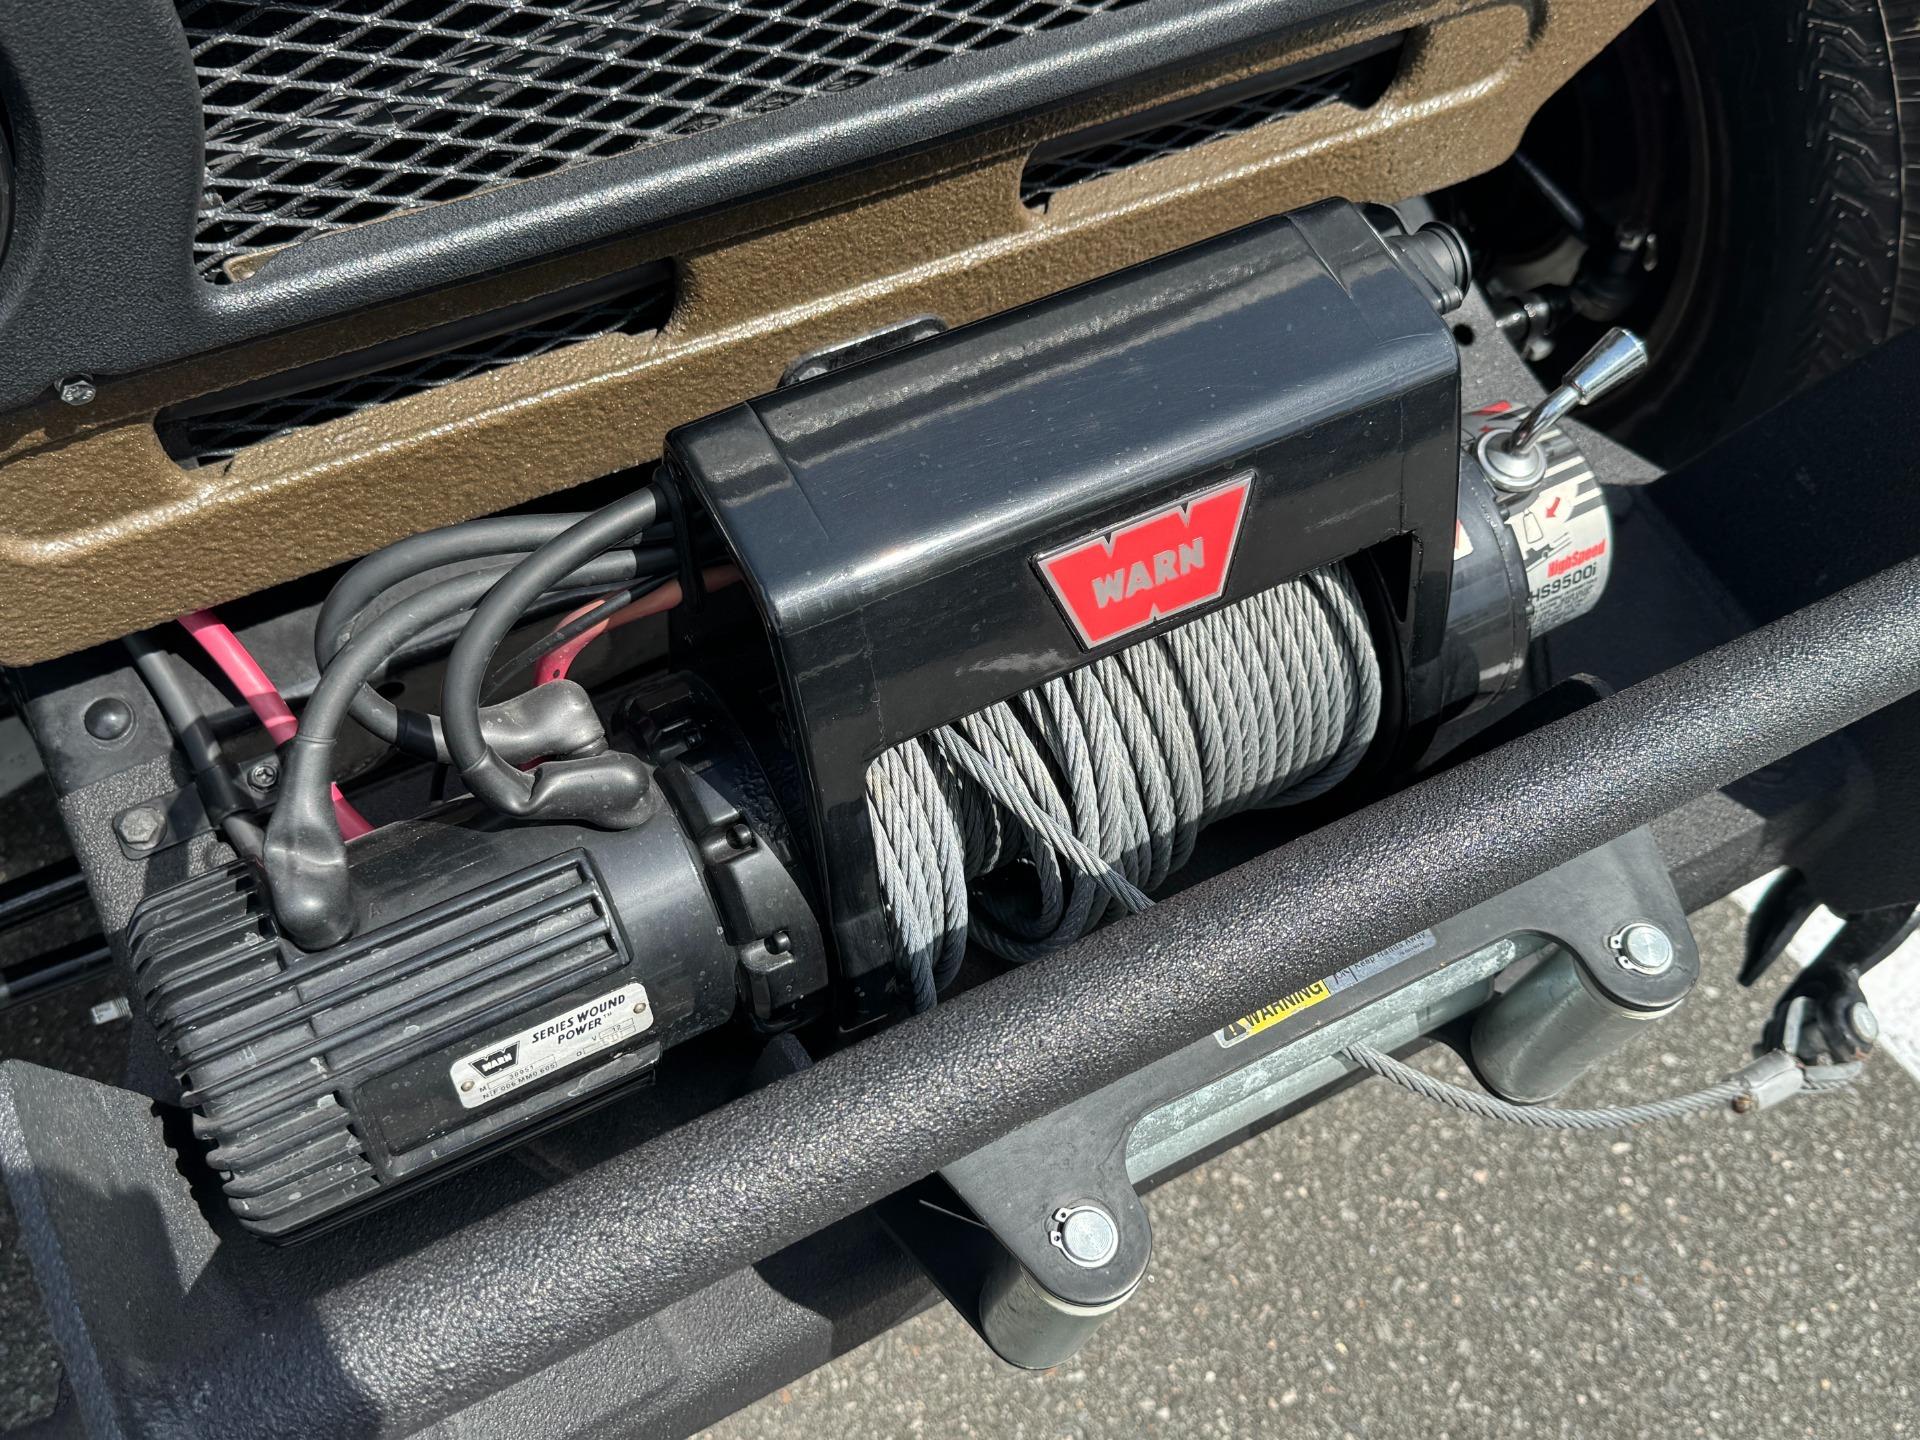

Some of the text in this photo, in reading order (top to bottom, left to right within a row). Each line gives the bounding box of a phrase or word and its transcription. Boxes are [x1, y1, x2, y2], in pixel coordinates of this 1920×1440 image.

[1090, 536, 1206, 609] WARN
[531, 1016, 574, 1044] SERIES
[576, 994, 626, 1023] WOUND
[1244, 983, 1324, 1027] WARNING
[557, 1017, 602, 1045] POWER
[481, 1052, 513, 1072] WARN
